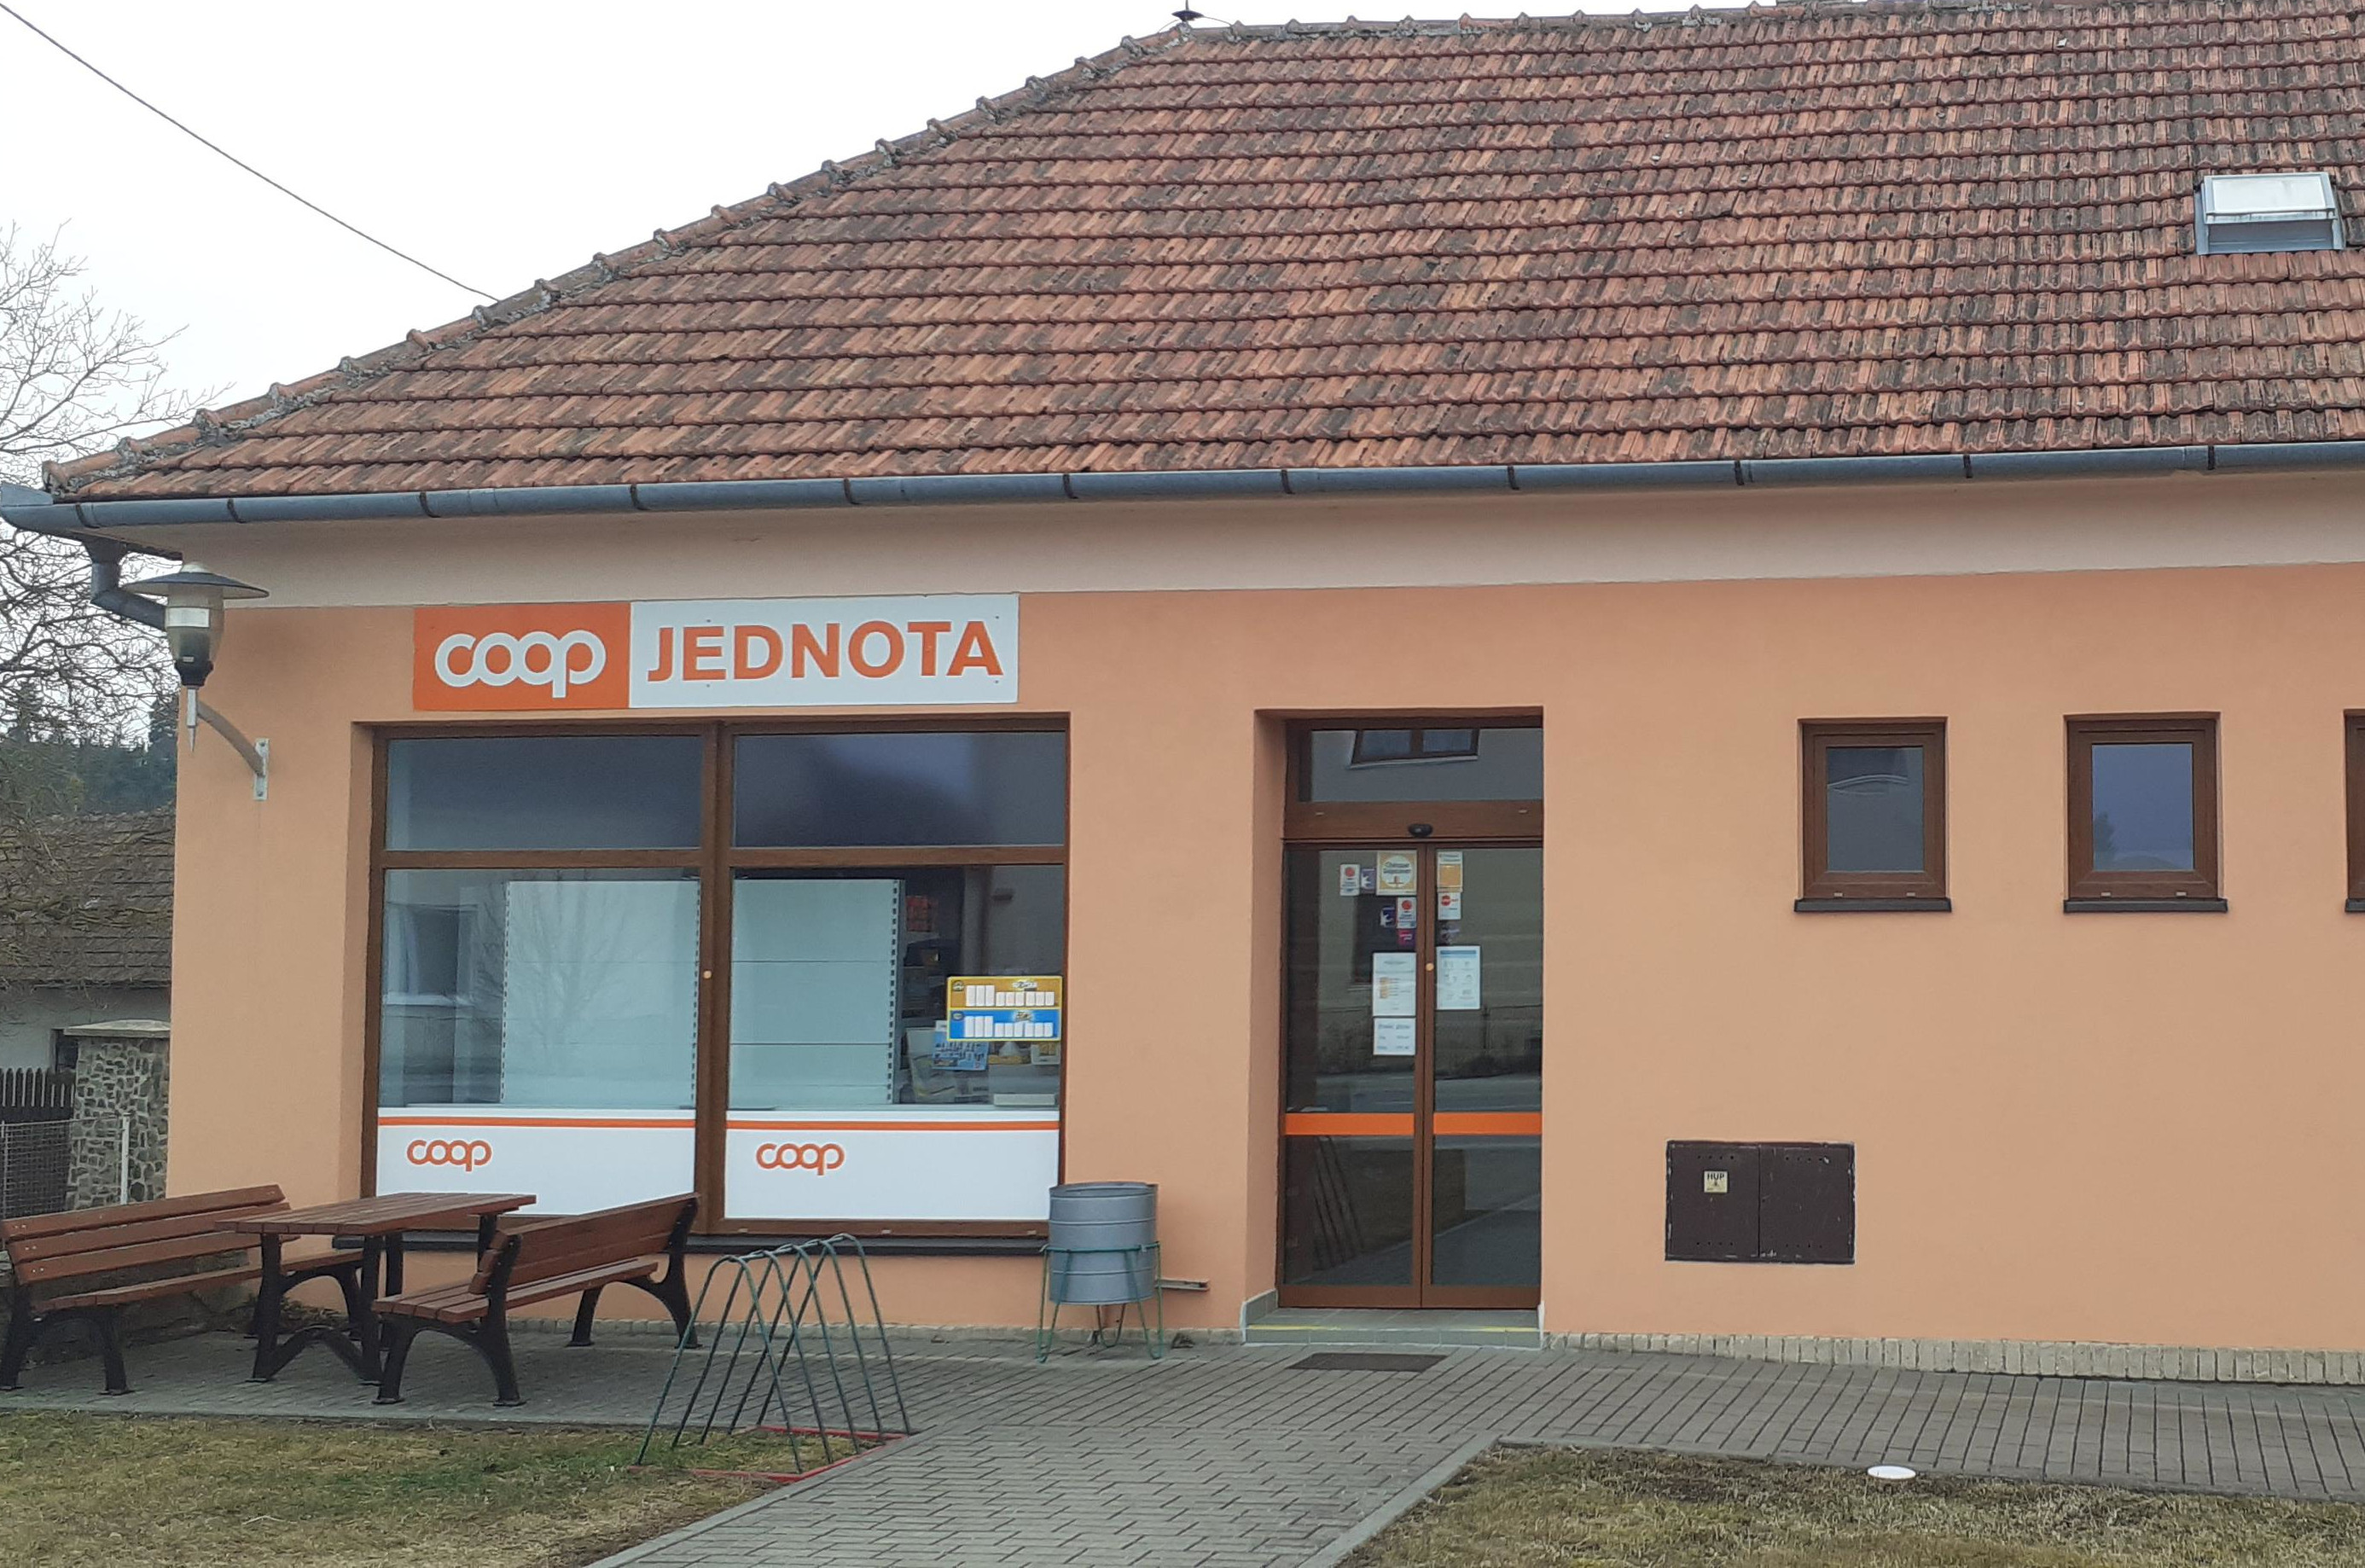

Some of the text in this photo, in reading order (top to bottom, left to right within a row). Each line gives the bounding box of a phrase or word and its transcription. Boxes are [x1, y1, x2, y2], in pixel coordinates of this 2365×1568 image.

[435, 620, 1003, 699] coop JEDNOTA
[407, 1139, 492, 1171] coop
[756, 1143, 845, 1175] coop
